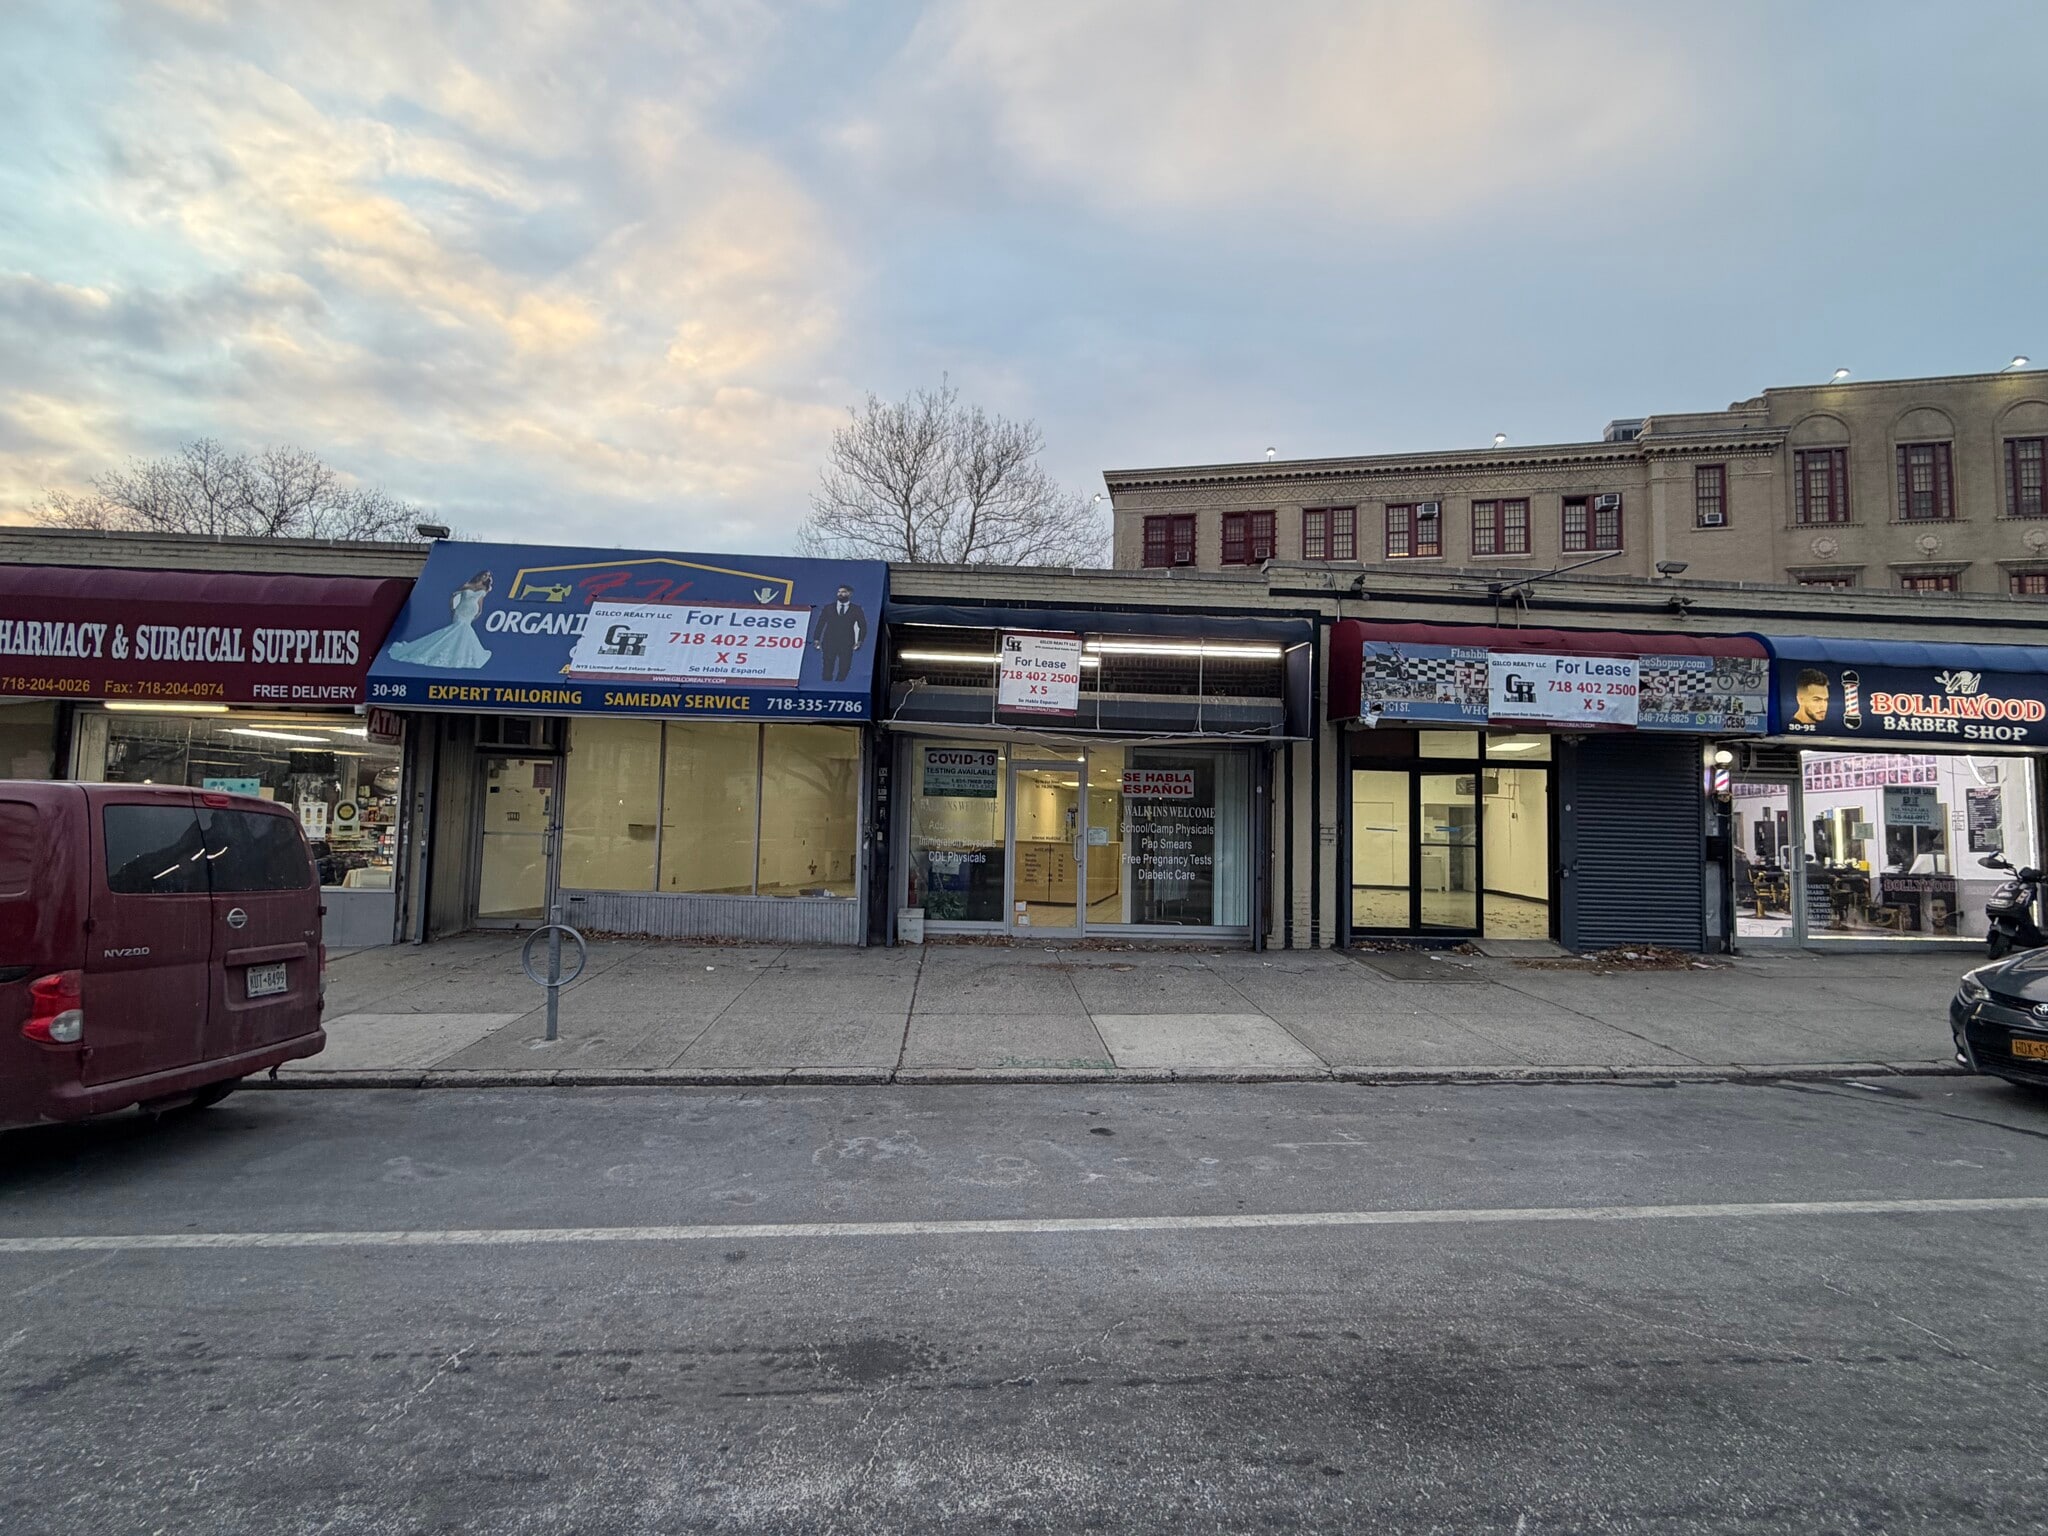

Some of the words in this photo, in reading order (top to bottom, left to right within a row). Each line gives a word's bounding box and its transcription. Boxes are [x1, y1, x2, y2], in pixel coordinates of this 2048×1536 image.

[595, 610, 622, 618] GILCO
[623, 611, 656, 620] REALTY
[656, 612, 673, 620] LLC
[685, 610, 725, 627] For
[729, 612, 797, 629] Lease
[111, 624, 129, 660] &
[135, 624, 246, 663] SURGICAL
[251, 627, 360, 665] SUPPLIES
[668, 632, 706, 645] 718
[711, 634, 749, 647] 402
[754, 635, 804, 649] 2500
[714, 652, 729, 664] X
[735, 653, 748, 665] 5
[1015, 656, 1032, 666] For
[1035, 658, 1067, 669] Lease
[689, 665, 701, 673] Se
[702, 666, 728, 674] Habla
[1555, 659, 1580, 674] For
[1585, 661, 1631, 677] Lease
[1001, 670, 1022, 680] 718
[1025, 671, 1047, 682] 402
[1050, 673, 1078, 684] 2500
[2, 677, 90, 692] 718-204-0026
[104, 680, 133, 694] Fax:
[137, 682, 224, 696] 718-204-0974
[253, 685, 288, 698] FREE
[292, 686, 357, 699] DELIVERY
[372, 684, 407, 697] 30-98
[1030, 685, 1038, 694] X
[1041, 686, 1048, 695] 5
[1548, 681, 1572, 692] 718
[1576, 682, 1602, 694] 402
[1606, 683, 1637, 696] 2500
[428, 685, 490, 701] EXPERT
[494, 688, 582, 704] TAILORING
[604, 692, 682, 708] SAMEDAY
[684, 695, 750, 710] SERVICE
[766, 698, 863, 713] 718-335-7786
[1583, 698, 1592, 710] X
[1596, 699, 1605, 711] 5
[1870, 691, 2046, 722] BOLLIWOOD
[371, 711, 401, 735] ATM
[1788, 723, 1816, 733] 30-92
[1883, 716, 1960, 734] BARBER
[1963, 725, 2028, 741] SHOP
[928, 753, 995, 766] COVID-19
[1123, 772, 1141, 782] SE
[1145, 773, 1192, 783] HABLA
[1123, 783, 1192, 794] ESPAÑOL
[1124, 805, 1168, 817] WALK-INS
[1169, 806, 1216, 818] WELCOME
[1120, 822, 1174, 835] School/Camp
[1175, 823, 1214, 836] Physicals
[1141, 838, 1158, 850] Pap
[1160, 839, 1193, 850] Smears
[928, 851, 946, 862] CDL
[948, 851, 987, 865] Physicals
[1121, 854, 1141, 864] Free
[1143, 854, 1189, 867] Pregnancy
[1190, 854, 1212, 865] Tests
[1138, 868, 1173, 880] Diabetic
[1174, 869, 1196, 880] Care
[104, 946, 150, 958] NV200
